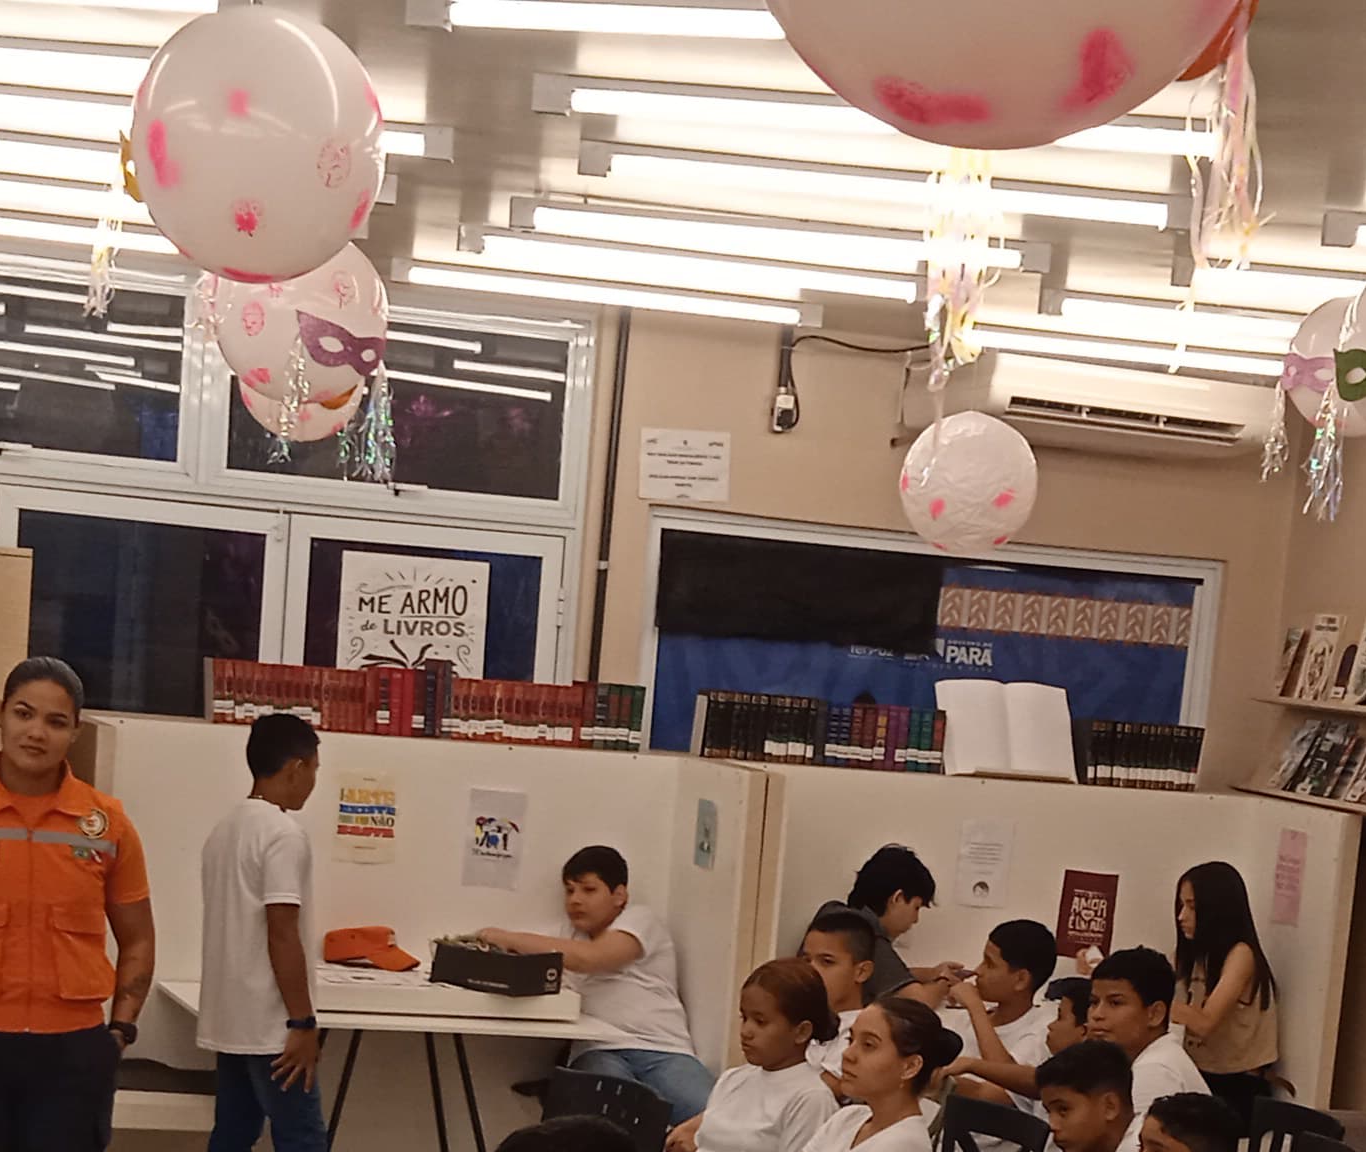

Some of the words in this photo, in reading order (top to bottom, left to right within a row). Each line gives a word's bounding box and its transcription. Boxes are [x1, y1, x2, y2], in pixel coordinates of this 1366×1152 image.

[358, 594, 392, 614] ME
[399, 585, 468, 616] ARMO
[360, 620, 377, 631] de
[383, 619, 466, 637] LIVROS
[1071, 896, 1108, 918] AMOR
